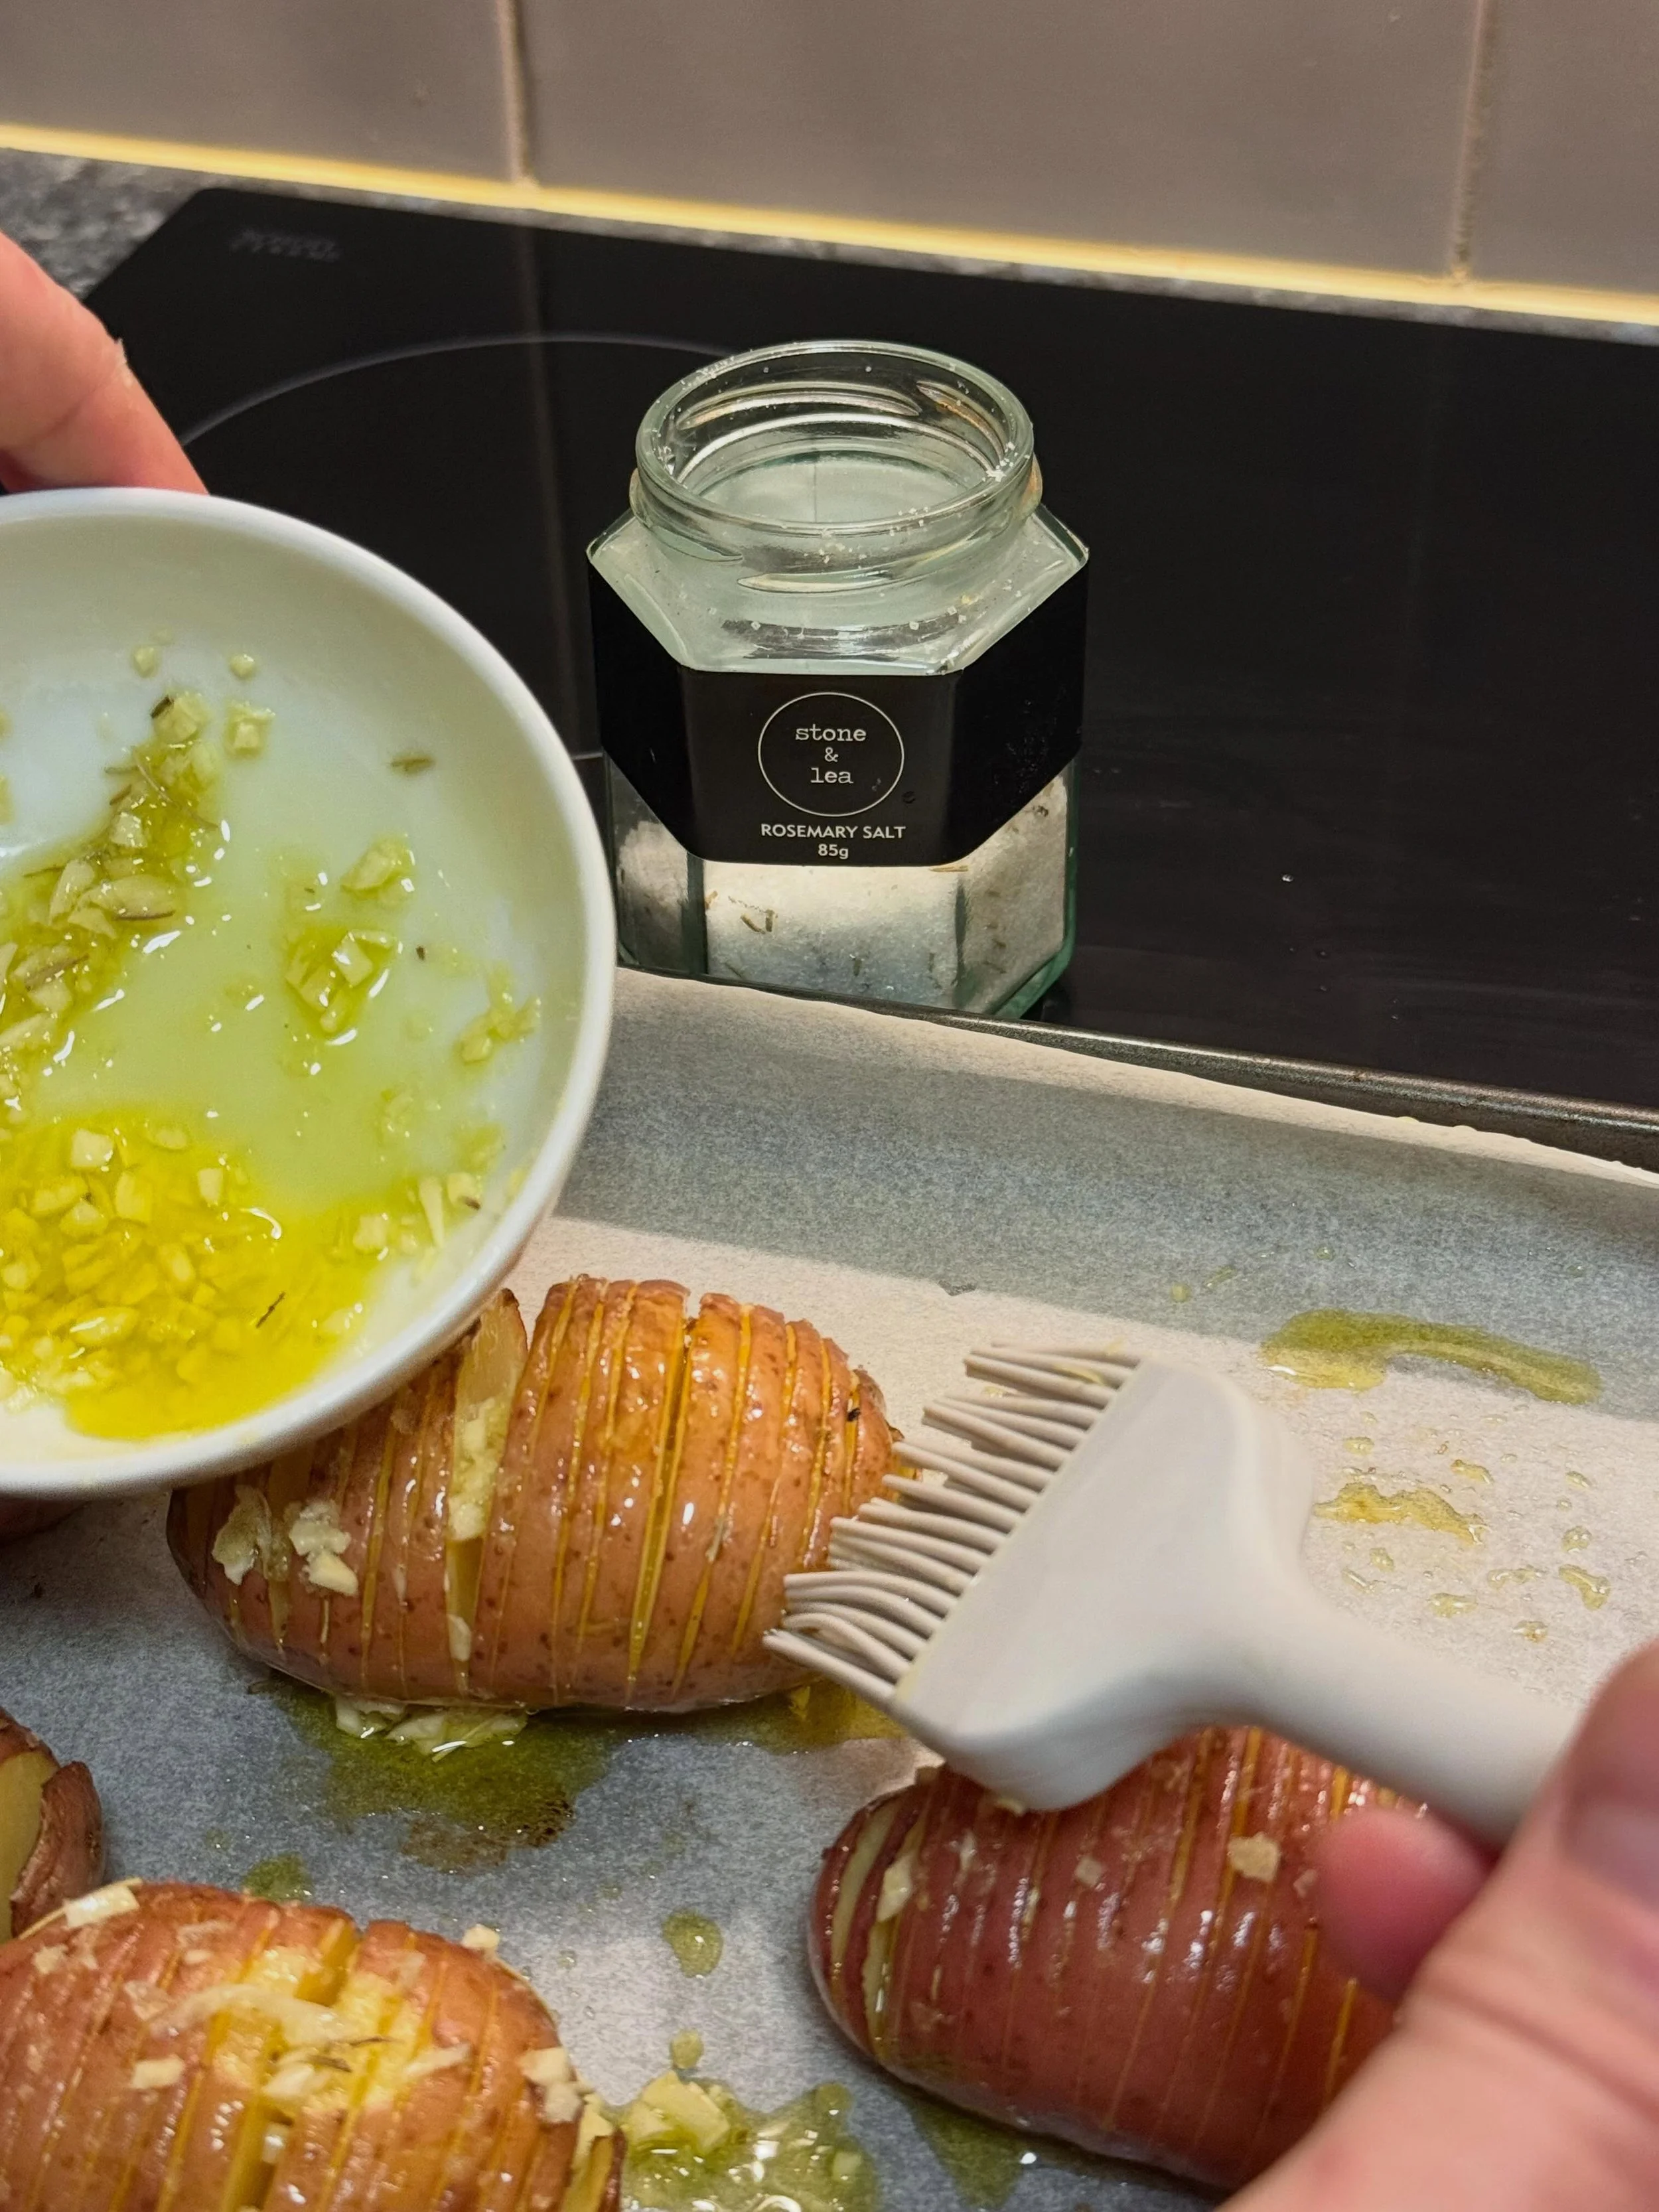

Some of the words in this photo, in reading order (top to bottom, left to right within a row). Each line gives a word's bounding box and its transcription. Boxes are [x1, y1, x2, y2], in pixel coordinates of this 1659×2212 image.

[795, 723, 867, 741] stone
[824, 747, 839, 763] &
[810, 767, 853, 784] lea
[760, 823, 858, 838] ROSEMARY
[863, 826, 906, 839] SALT
[818, 844, 849, 859] 85g
